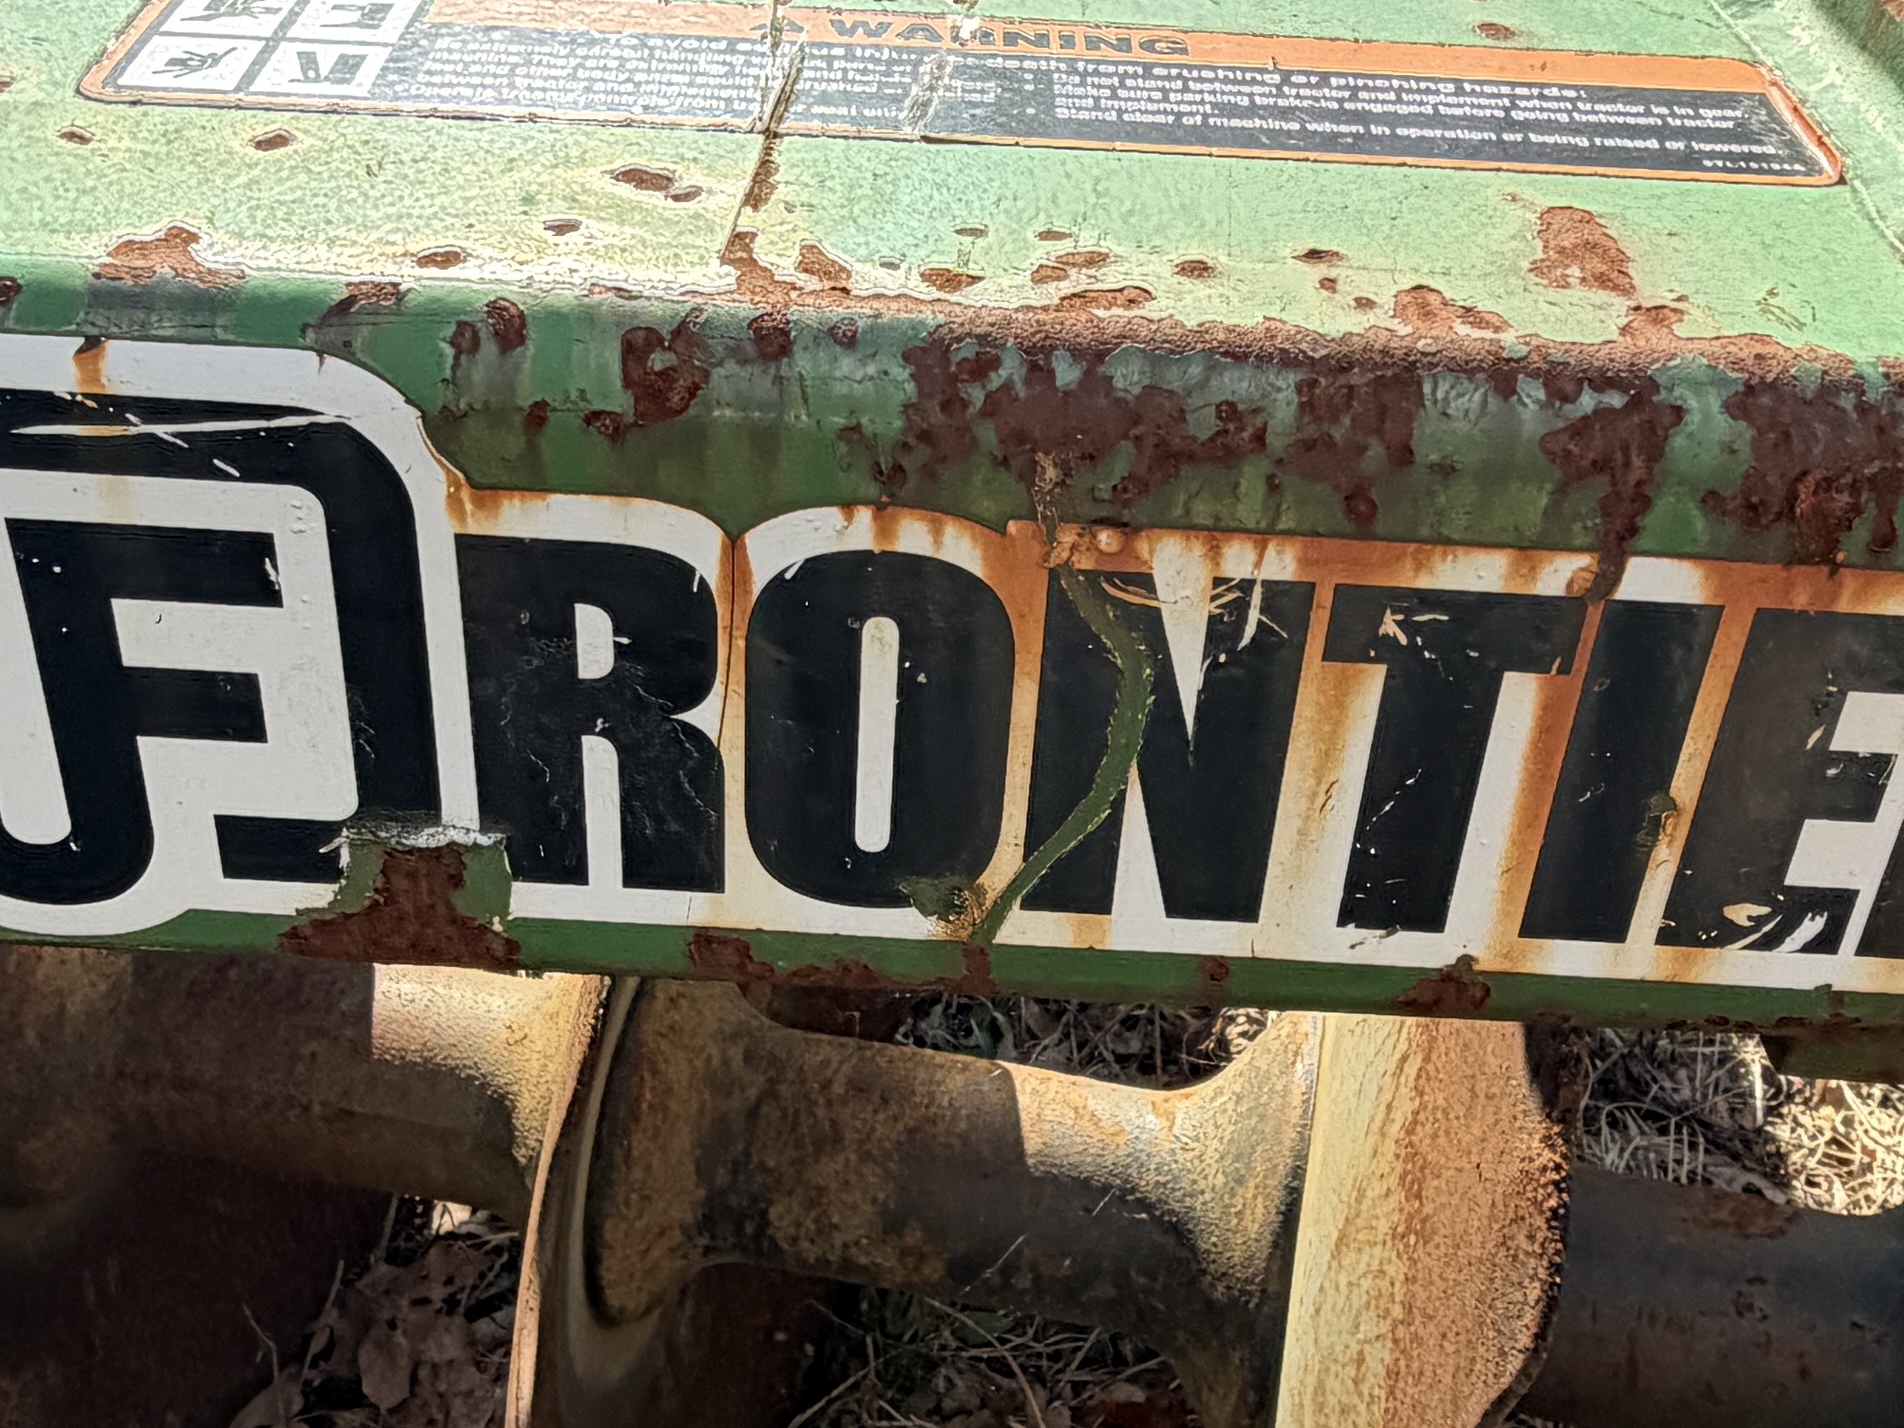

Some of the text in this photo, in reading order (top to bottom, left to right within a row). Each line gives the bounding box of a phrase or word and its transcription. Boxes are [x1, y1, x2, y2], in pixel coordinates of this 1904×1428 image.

[829, 18, 1191, 57] WARNING
[645, 35, 728, 51] avoid
[1078, 61, 1143, 75] from
[1152, 64, 1280, 83] crushing
[1290, 73, 1319, 84] or
[1330, 75, 1454, 93] pinching
